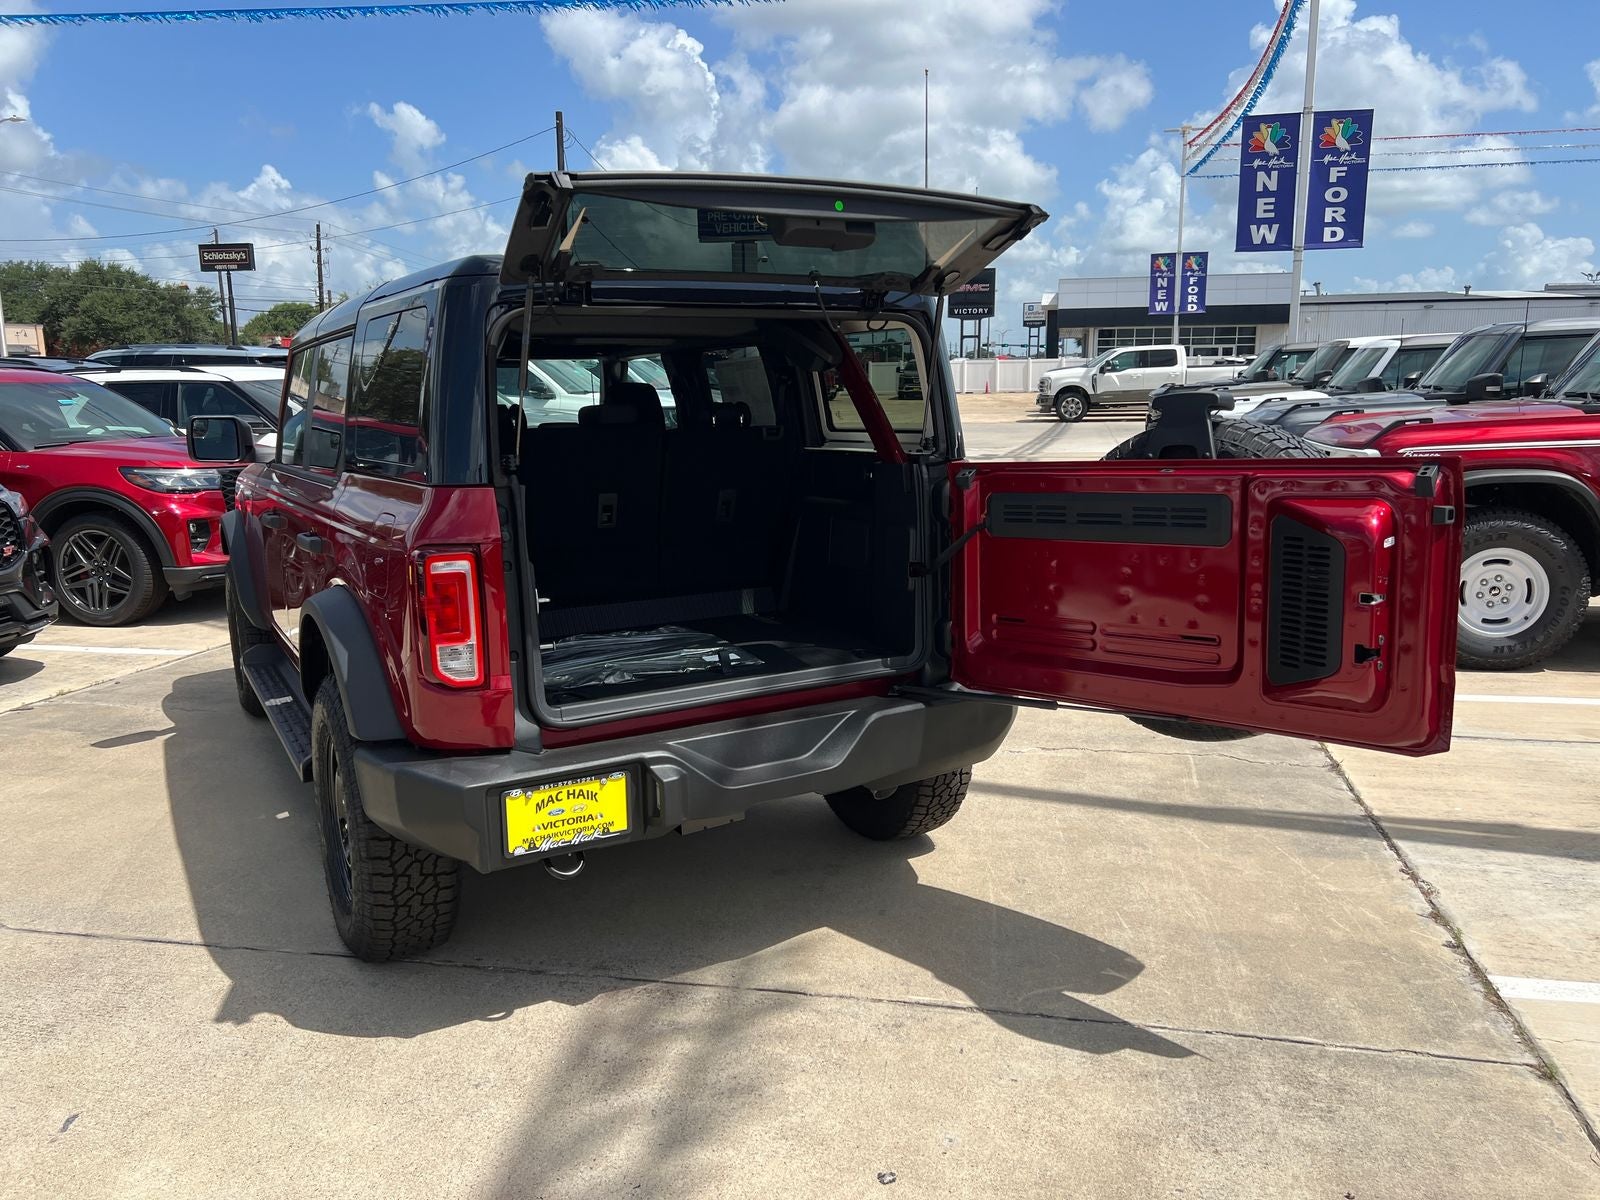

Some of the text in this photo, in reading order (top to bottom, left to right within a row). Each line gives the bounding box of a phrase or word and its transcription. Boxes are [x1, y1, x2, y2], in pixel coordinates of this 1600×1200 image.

[1249, 170, 1279, 245] NEW
[1322, 166, 1349, 243] FORD
[714, 222, 768, 234] VEHICLES
[203, 251, 246, 260] Schlotzsky's
[960, 283, 989, 291] MC
[1154, 277, 1169, 311] NEW
[1187, 276, 1198, 311] FORD
[953, 307, 989, 315] VICTORY
[535, 788, 598, 814] MAC HAIK
[541, 813, 595, 830] VICTORIA
[538, 827, 607, 852] Mac Haik
